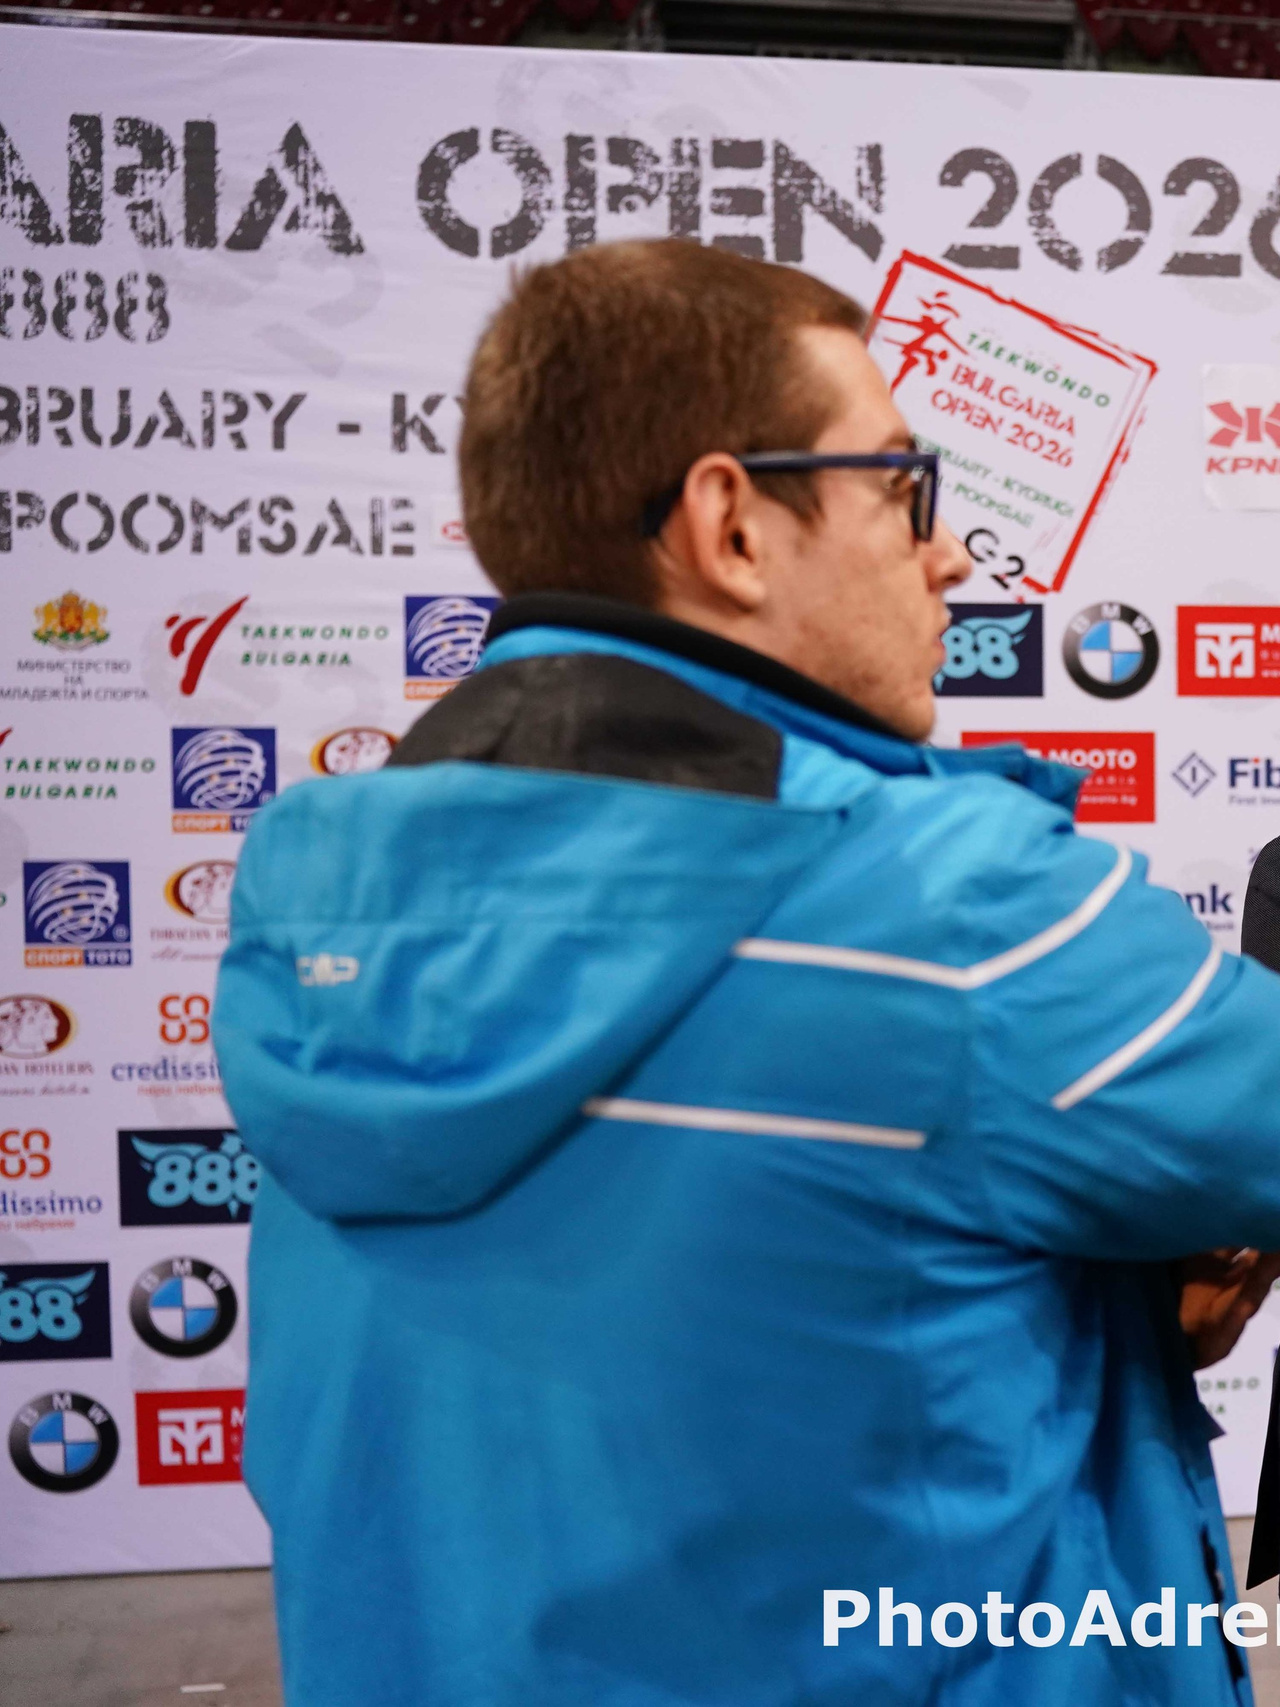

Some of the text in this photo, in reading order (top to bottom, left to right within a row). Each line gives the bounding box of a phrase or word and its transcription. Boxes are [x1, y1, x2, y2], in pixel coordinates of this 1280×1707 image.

[416, 127, 884, 262] OPEN
[965, 333, 1112, 408] TAEKWONDO
[951, 364, 1076, 437] BULGARIA
[392, 392, 468, 454] K
[931, 388, 1073, 469] OPEN 2026
[0, 490, 415, 557] POOMSAE
[241, 624, 390, 640] TAEKWONDO
[17, 659, 132, 673] МИНИСТЕРСТВО
[241, 652, 352, 667] BULGARIA
[5, 758, 156, 773] TAEKWONDO
[5, 785, 118, 799] BULGARIA
[173, 816, 229, 830] СПОРТ
[26, 951, 130, 965] СПОРТ ТОТО
[111, 1054, 222, 1081] credissi
